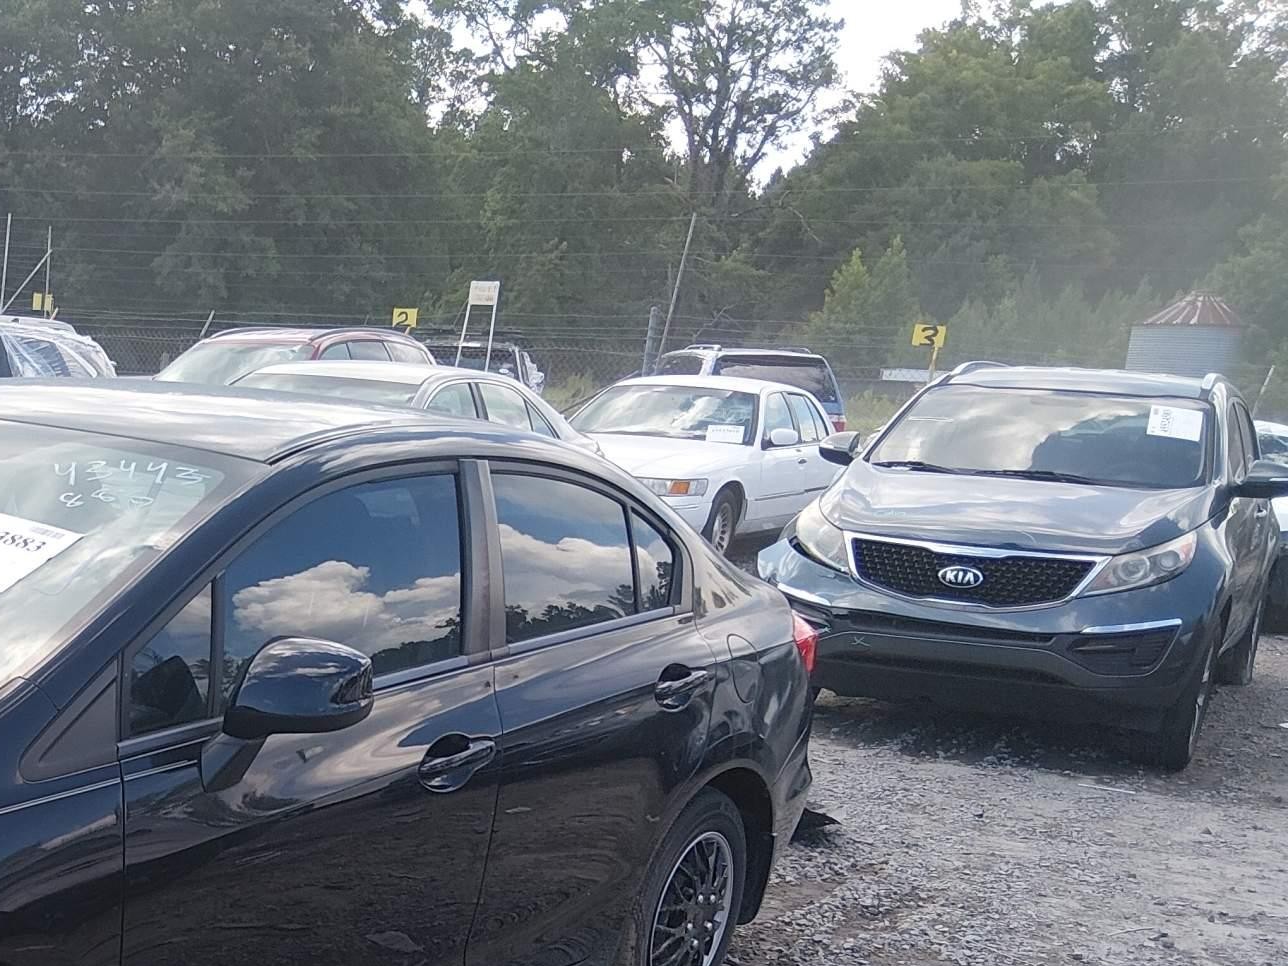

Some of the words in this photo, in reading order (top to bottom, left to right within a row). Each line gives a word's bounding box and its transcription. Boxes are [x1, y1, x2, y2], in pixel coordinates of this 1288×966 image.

[394, 311, 411, 328] 2
[920, 326, 939, 346] 3
[54, 459, 211, 486] 43443
[945, 570, 975, 585] KIA
